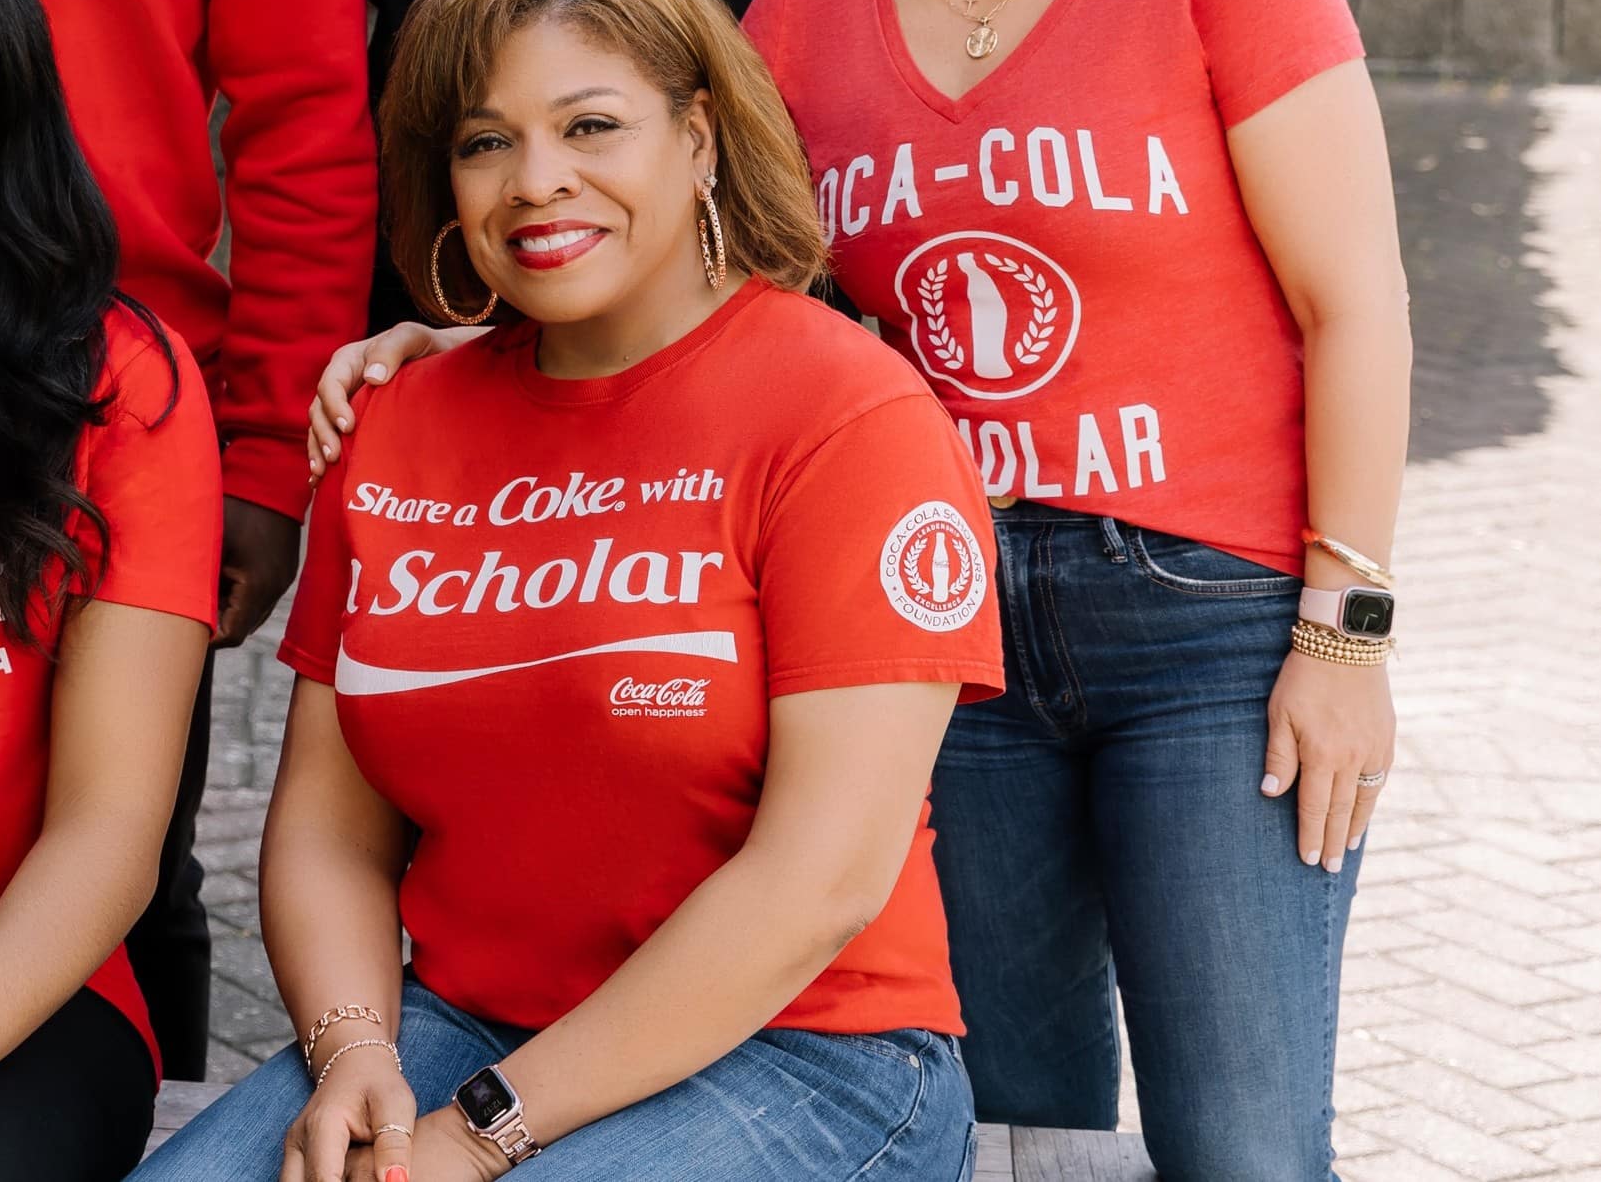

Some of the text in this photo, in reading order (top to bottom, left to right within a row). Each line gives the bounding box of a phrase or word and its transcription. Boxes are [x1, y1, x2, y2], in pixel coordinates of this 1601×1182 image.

[813, 127, 1189, 247] OCA-COLA
[958, 403, 1166, 498] OLAR
[347, 483, 451, 525] Share
[453, 504, 476, 526] a
[640, 468, 724, 505] with
[368, 538, 723, 616] Scholar
[886, 507, 983, 583] COCA-COLA SCHOLARS
[895, 595, 976, 627] FOUNDATION
[609, 676, 711, 706] Coca-Cola
[611, 708, 641, 717] open
